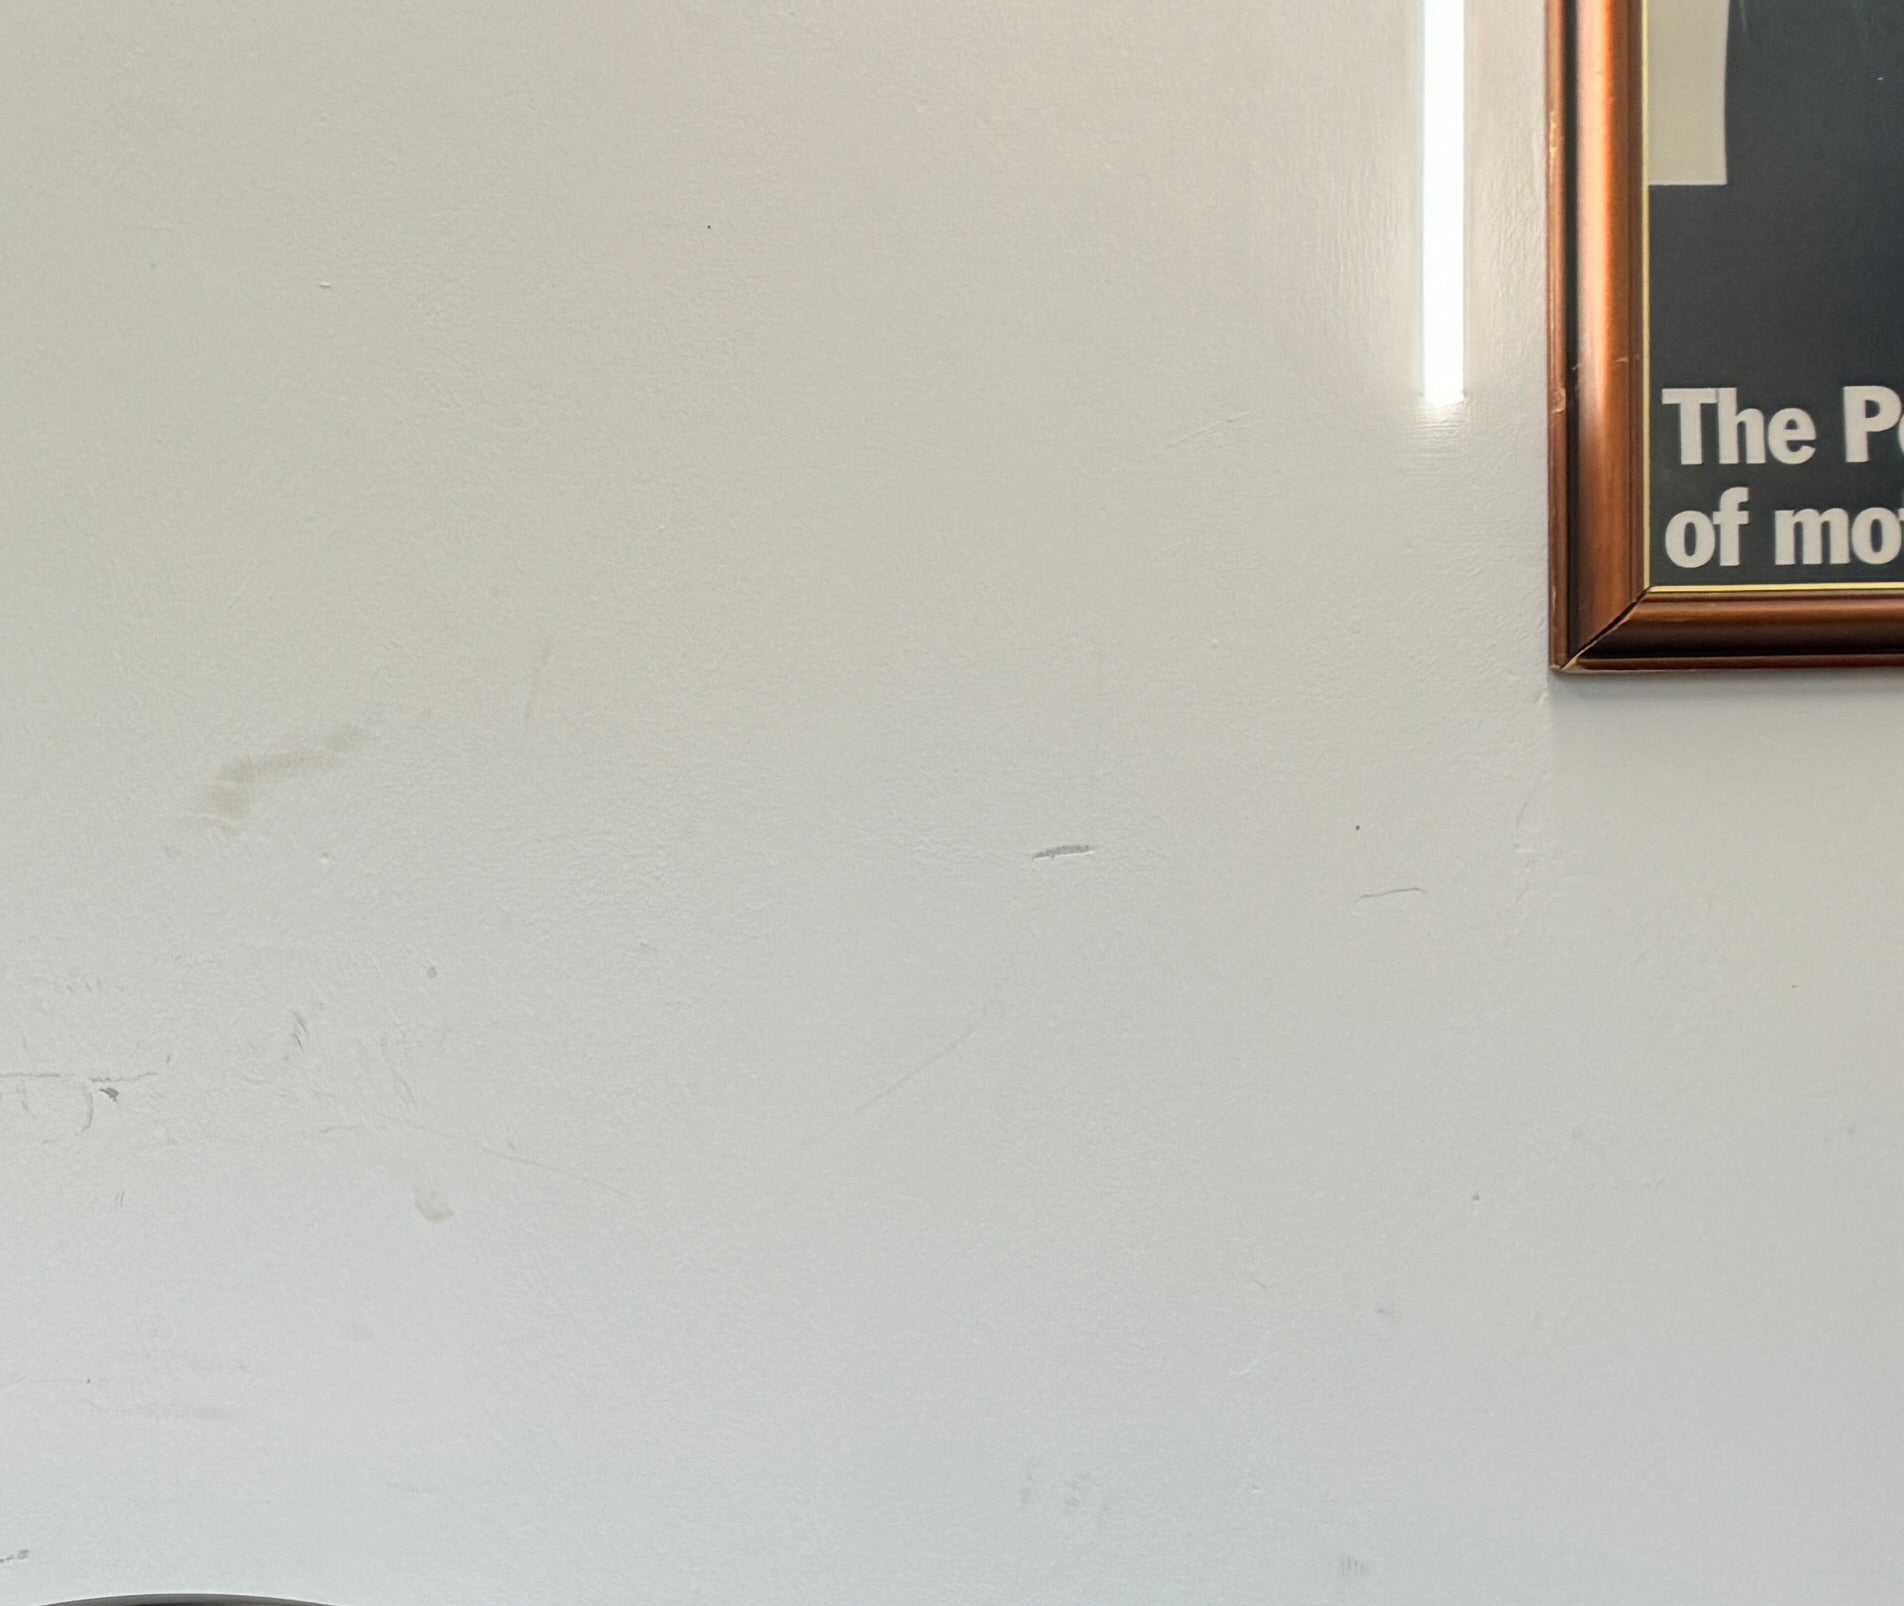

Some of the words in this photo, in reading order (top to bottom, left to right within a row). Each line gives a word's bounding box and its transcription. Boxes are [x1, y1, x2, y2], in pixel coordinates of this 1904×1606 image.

[1661, 386, 1816, 465] The
[1842, 385, 1904, 464] P
[1664, 486, 1750, 569] of
[1773, 505, 1904, 567] mo
